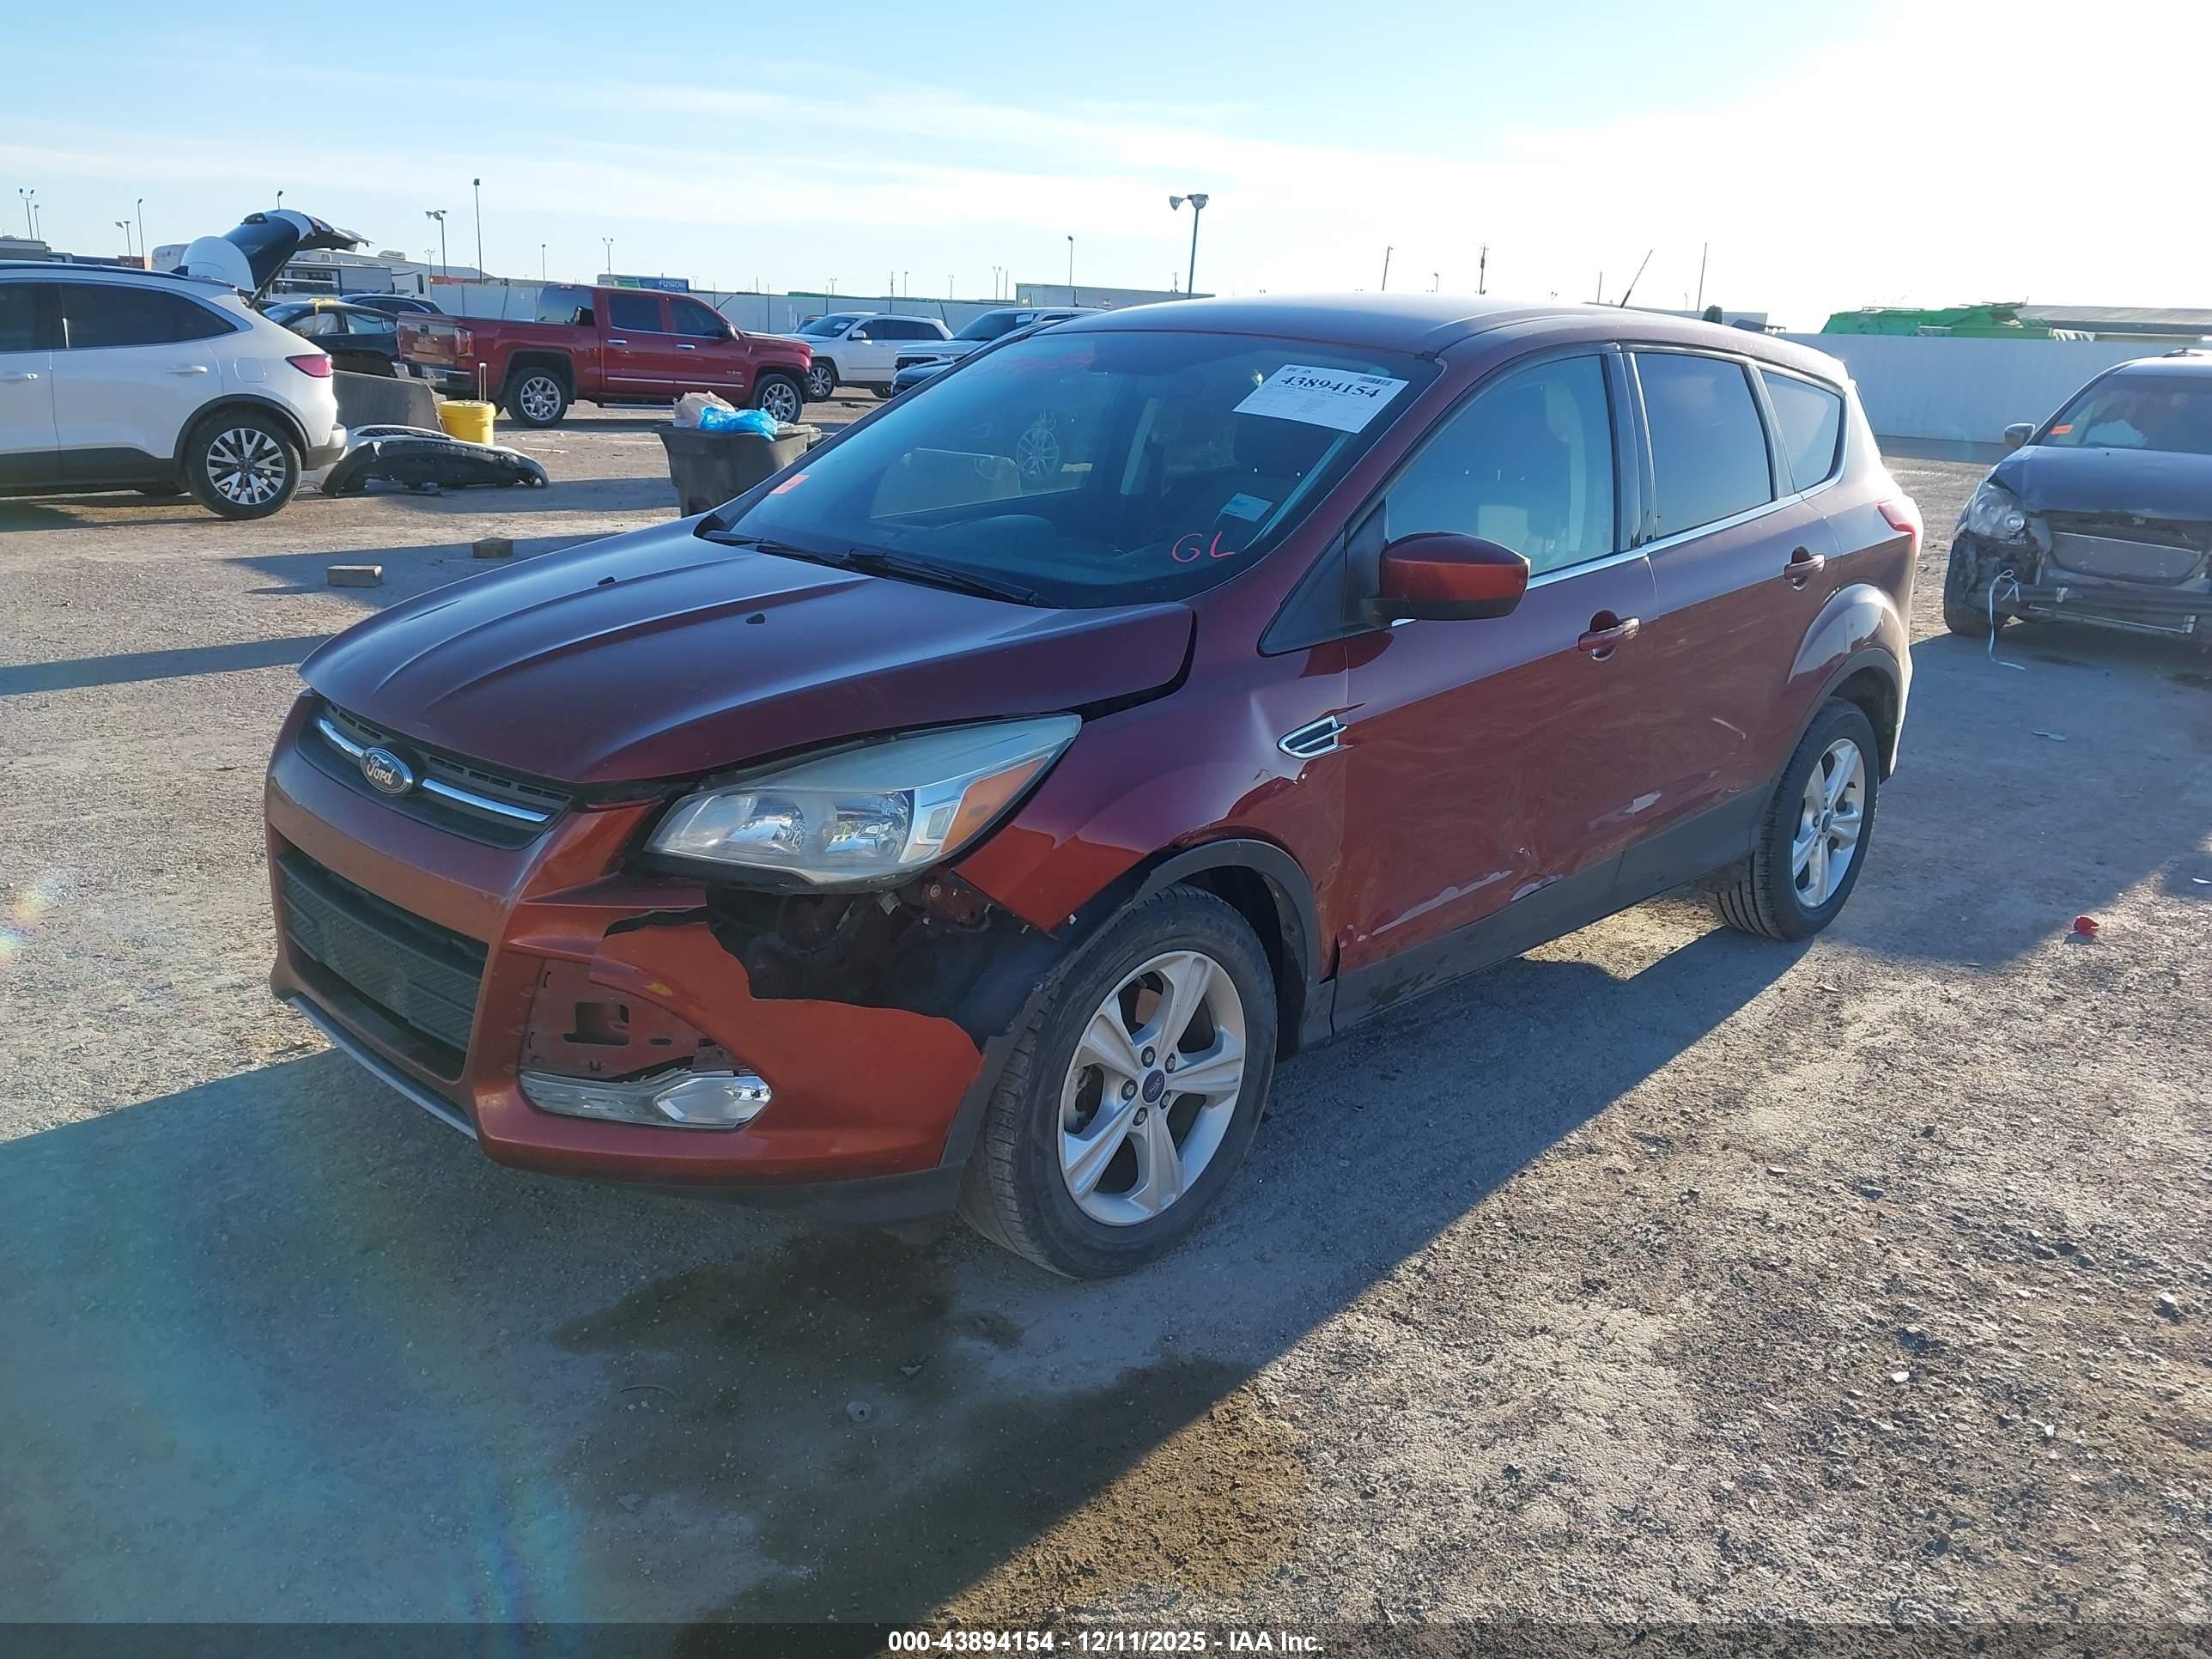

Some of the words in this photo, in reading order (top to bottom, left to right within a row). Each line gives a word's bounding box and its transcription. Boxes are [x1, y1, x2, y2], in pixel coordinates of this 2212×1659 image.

[659, 280, 685, 289] FUSION
[1280, 376, 1381, 398] 43894154
[1171, 531, 1237, 563] GL
[367, 754, 395, 785] Ford
